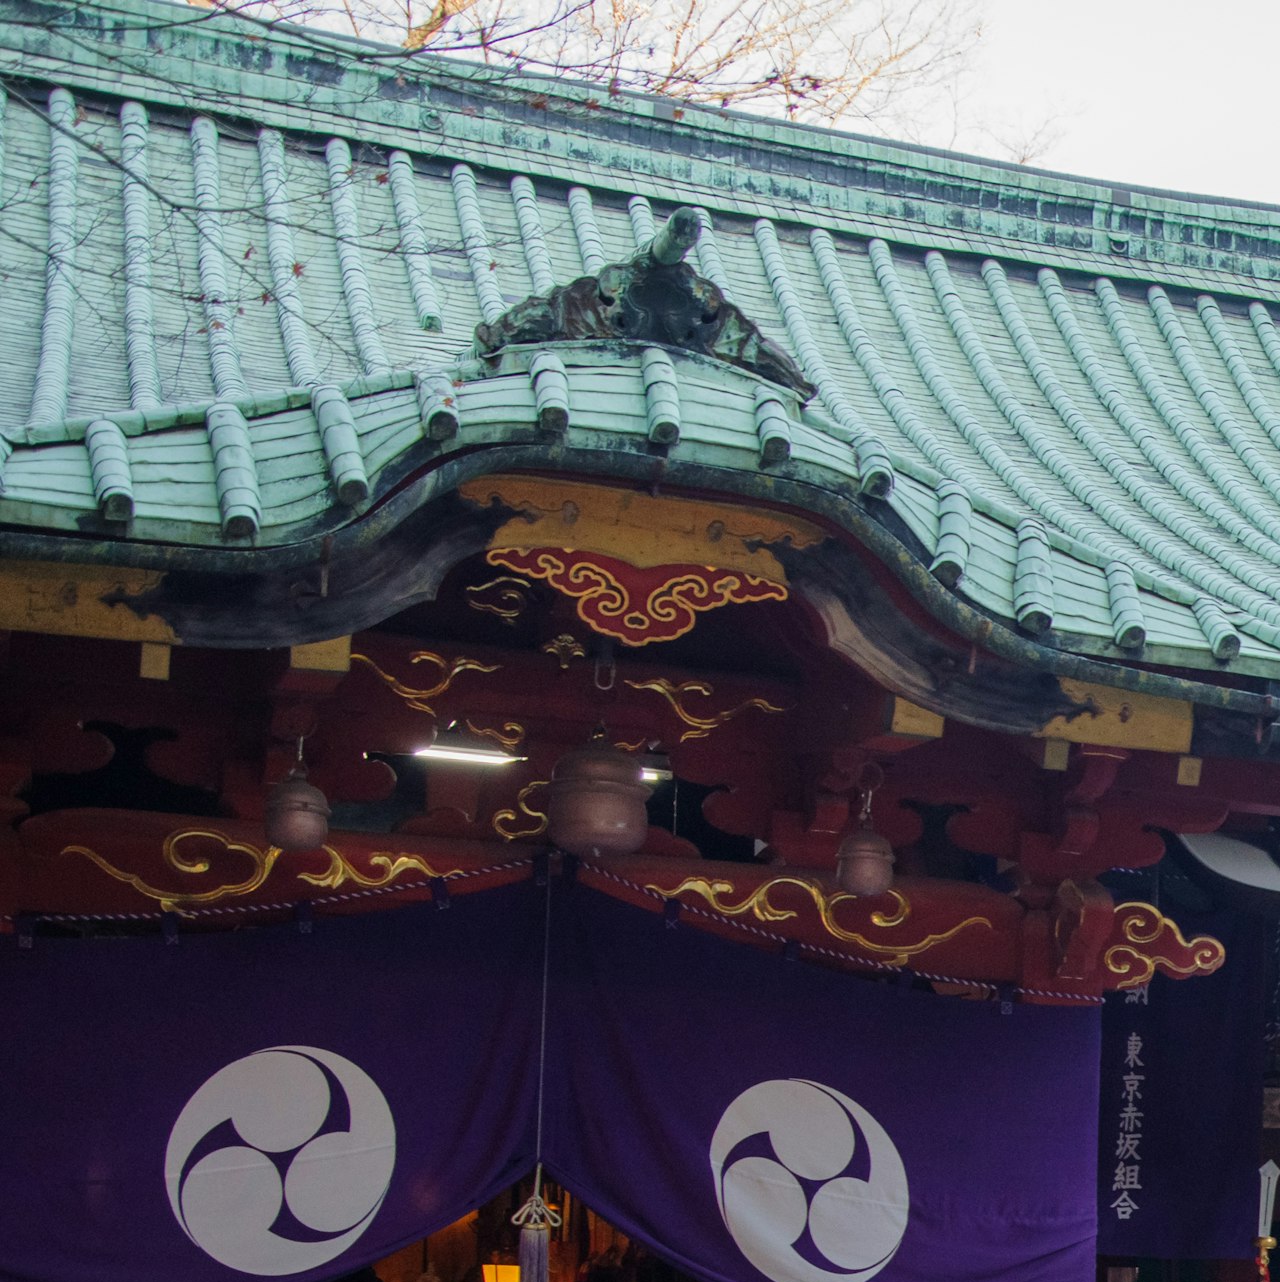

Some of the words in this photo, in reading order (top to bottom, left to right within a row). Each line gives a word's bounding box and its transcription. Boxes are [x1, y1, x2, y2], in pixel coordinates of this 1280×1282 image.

[1109, 1031, 1147, 1220] 東京赤坂組合
